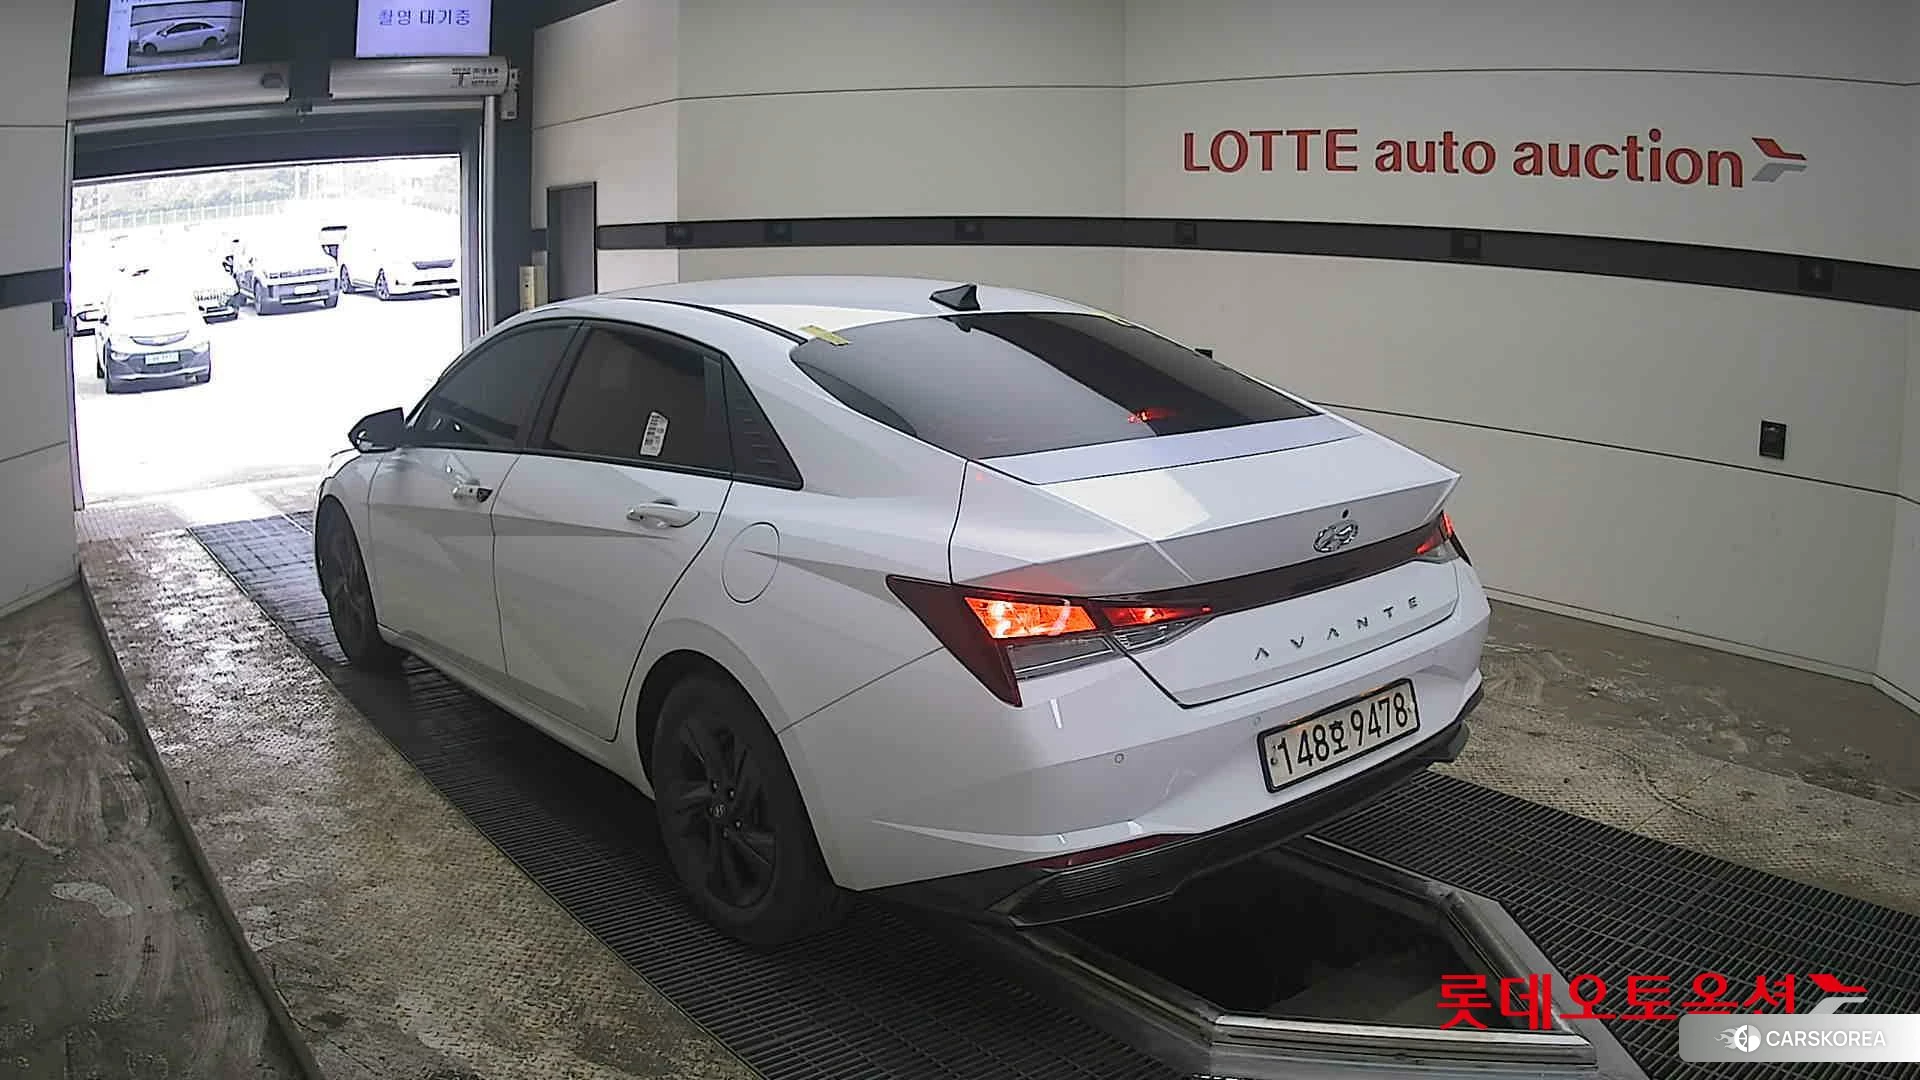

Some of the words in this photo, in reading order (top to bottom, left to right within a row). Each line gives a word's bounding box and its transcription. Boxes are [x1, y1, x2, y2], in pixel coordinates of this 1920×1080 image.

[420, 9, 470, 26] 대기중
[1183, 128, 1358, 172] LOTTE
[1374, 130, 1497, 175] auto
[1512, 128, 1744, 187] auction
[1254, 596, 1419, 662] AVANTE
